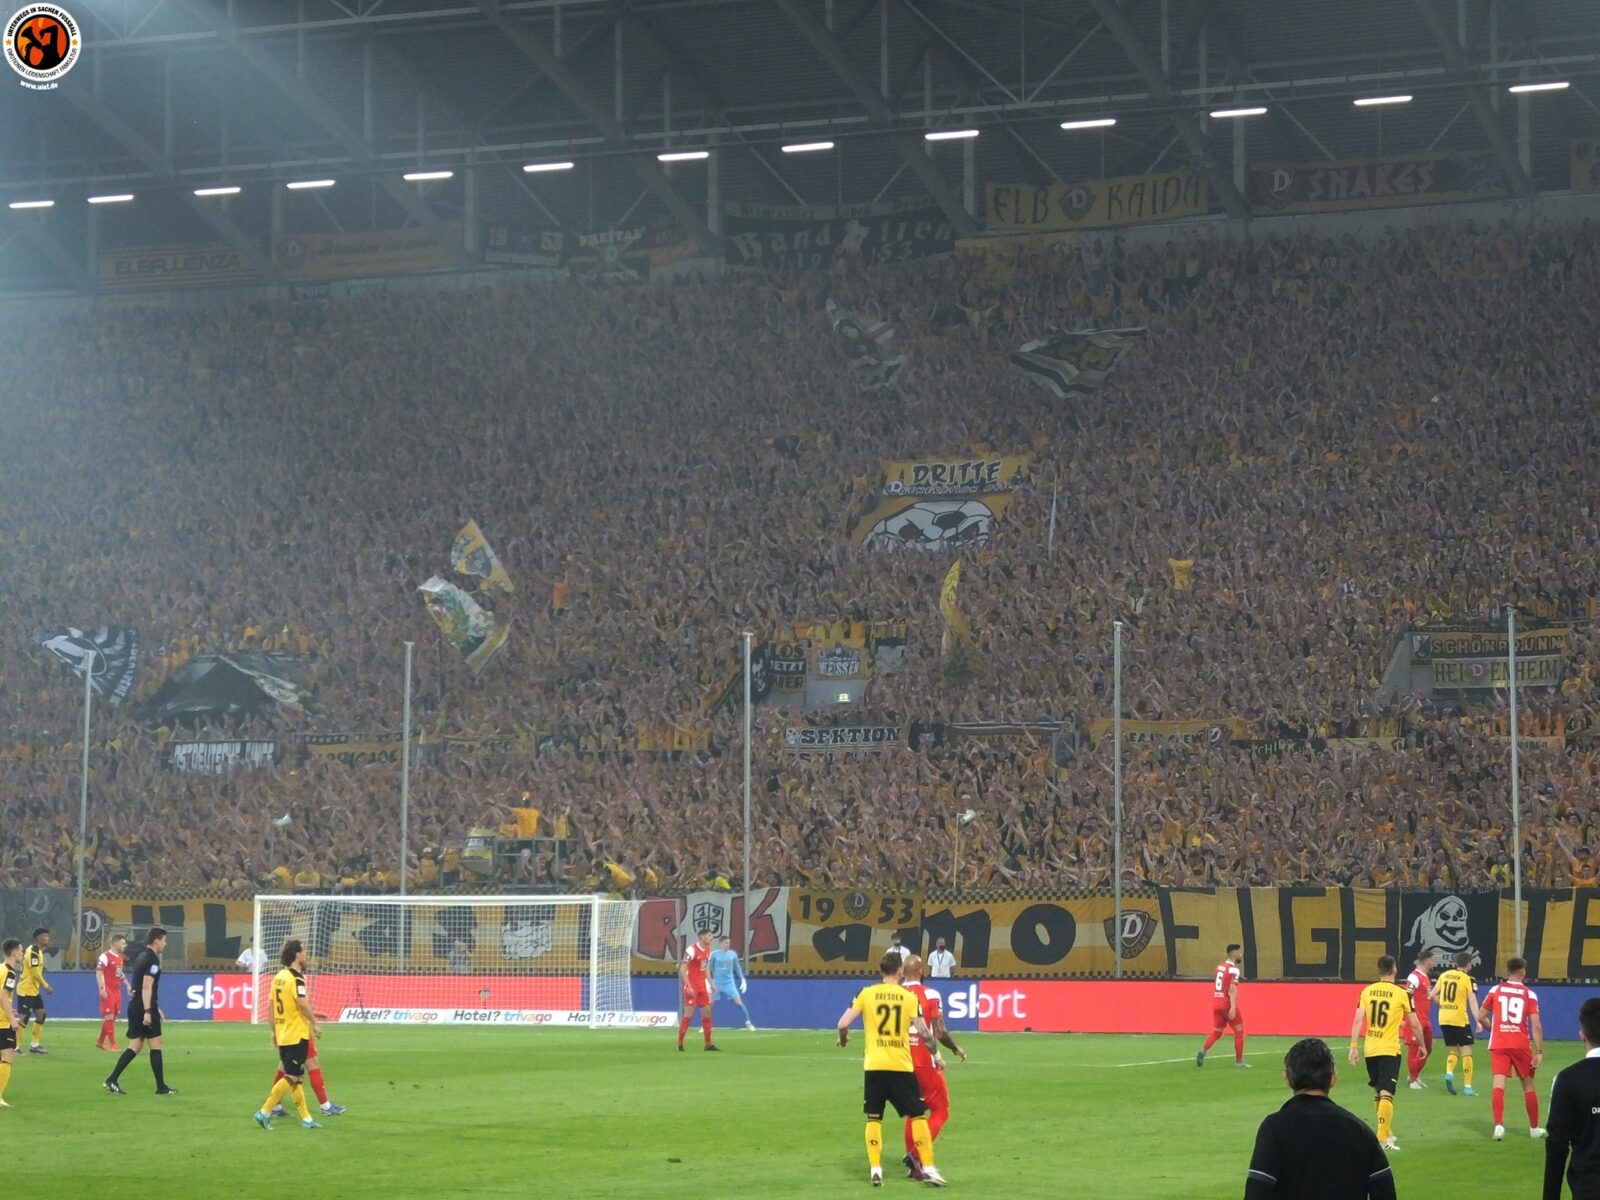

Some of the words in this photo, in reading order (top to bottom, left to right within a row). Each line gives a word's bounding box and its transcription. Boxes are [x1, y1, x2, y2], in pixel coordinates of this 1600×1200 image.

[1307, 161, 1436, 200] SNAKES
[994, 187, 1049, 225] ELB
[911, 460, 1001, 485] DRITTE
[800, 727, 901, 744] SEKTION
[799, 894, 835, 922] 19
[878, 897, 915, 925] 53
[1215, 971, 1224, 991] 6
[1443, 981, 1457, 1003] 10
[276, 988, 284, 1015] 5
[874, 992, 904, 1001] DRESDEN
[346, 1009, 391, 1021] Hotel?
[393, 1009, 439, 1025] trivago
[453, 1009, 501, 1021] Hotel?
[503, 1010, 553, 1025] trivago
[618, 1012, 668, 1027] trivago
[876, 1003, 903, 1037] 21
[1369, 999, 1390, 1028] 16
[1498, 995, 1525, 1024] 19
